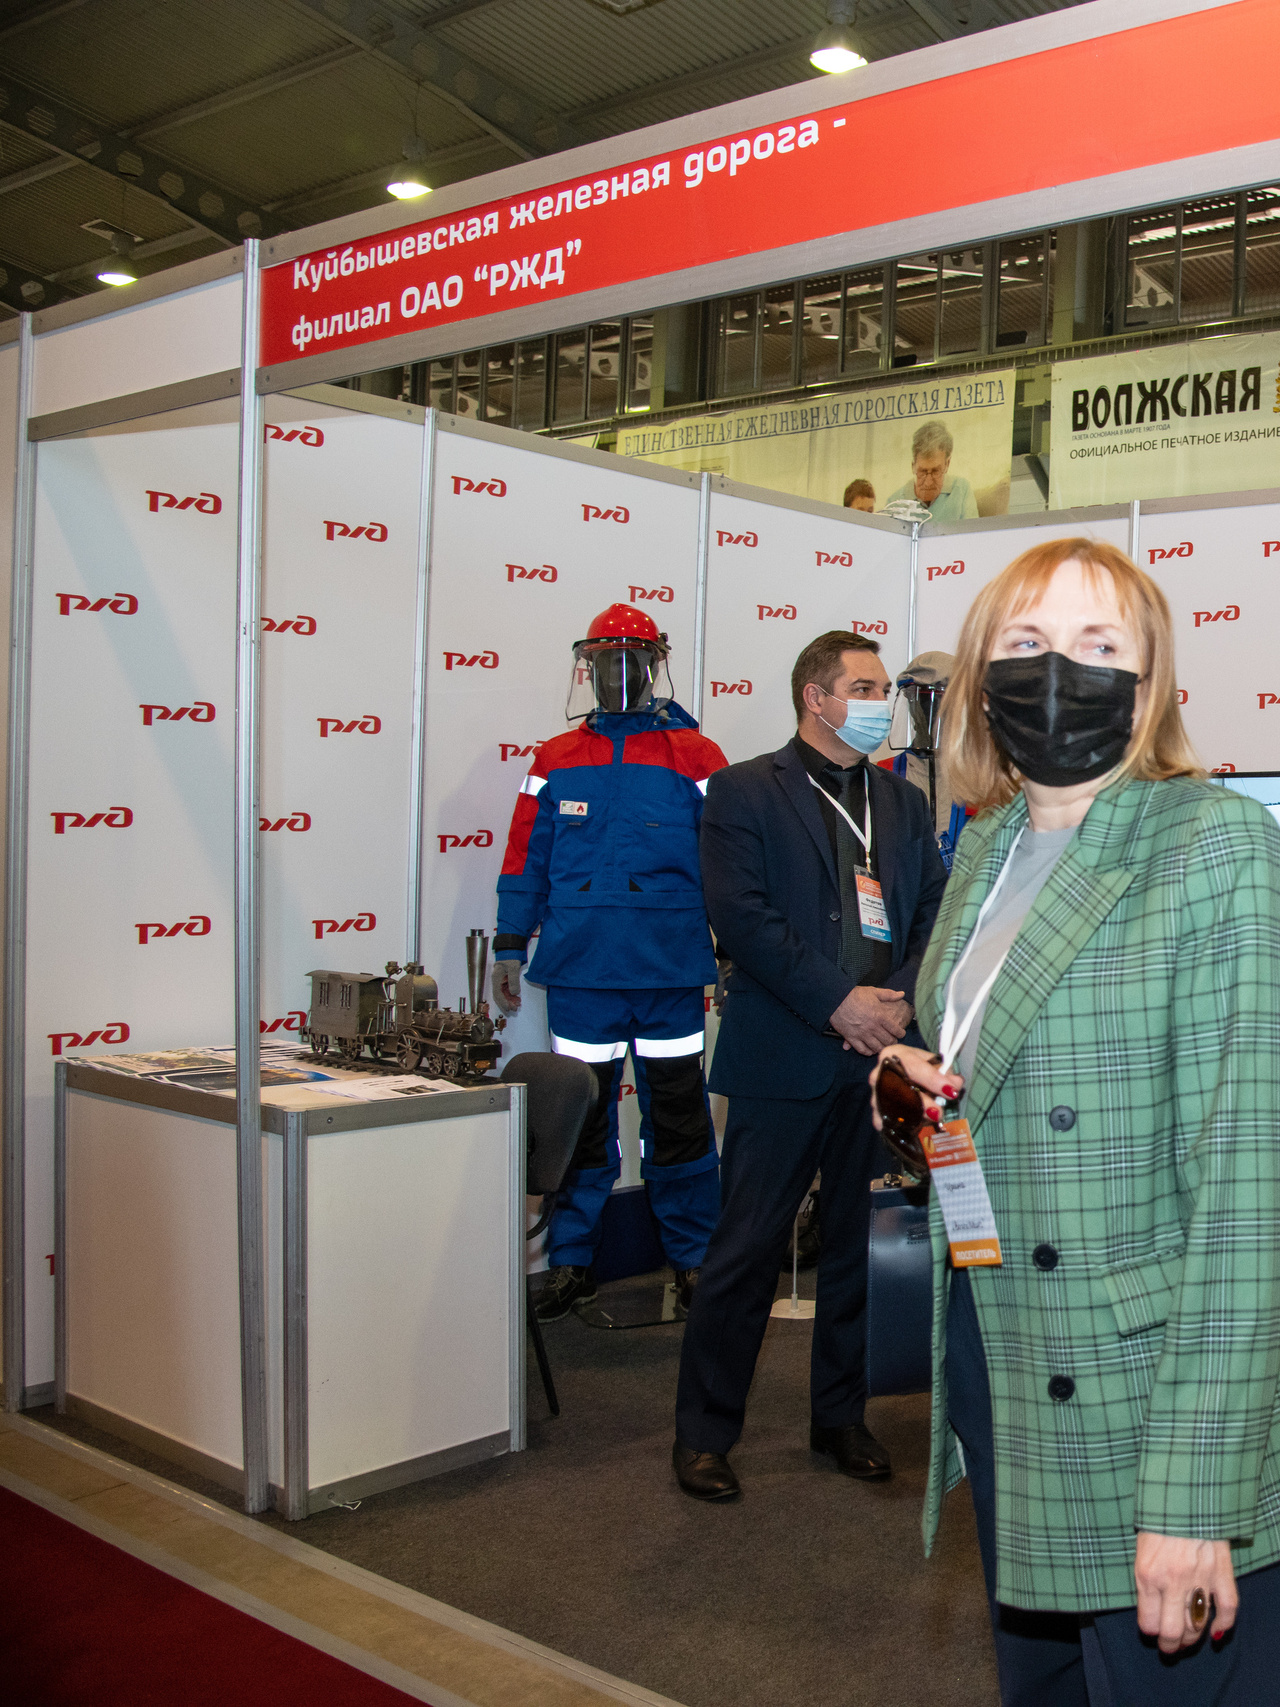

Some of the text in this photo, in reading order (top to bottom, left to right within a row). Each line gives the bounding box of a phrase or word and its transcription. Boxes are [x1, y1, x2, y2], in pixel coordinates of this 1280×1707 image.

[293, 211, 499, 293] Куйбышевская
[509, 161, 670, 229] железная
[684, 119, 820, 188] дорога
[291, 301, 391, 351] филиал
[400, 275, 463, 318] ОАО
[625, 380, 1005, 456] ЕДИНСТВЕННАЯ ЕЖЕДНЕВНАЯ ГОРОДСКАЯ ГАЗЕТА
[1072, 366, 1261, 432] ВОЛЖСКАЯ
[1070, 440, 1158, 459] ОФИЦИАЛЬНОЕ
[1161, 433, 1221, 449] ПЕЧАТНОЕ
